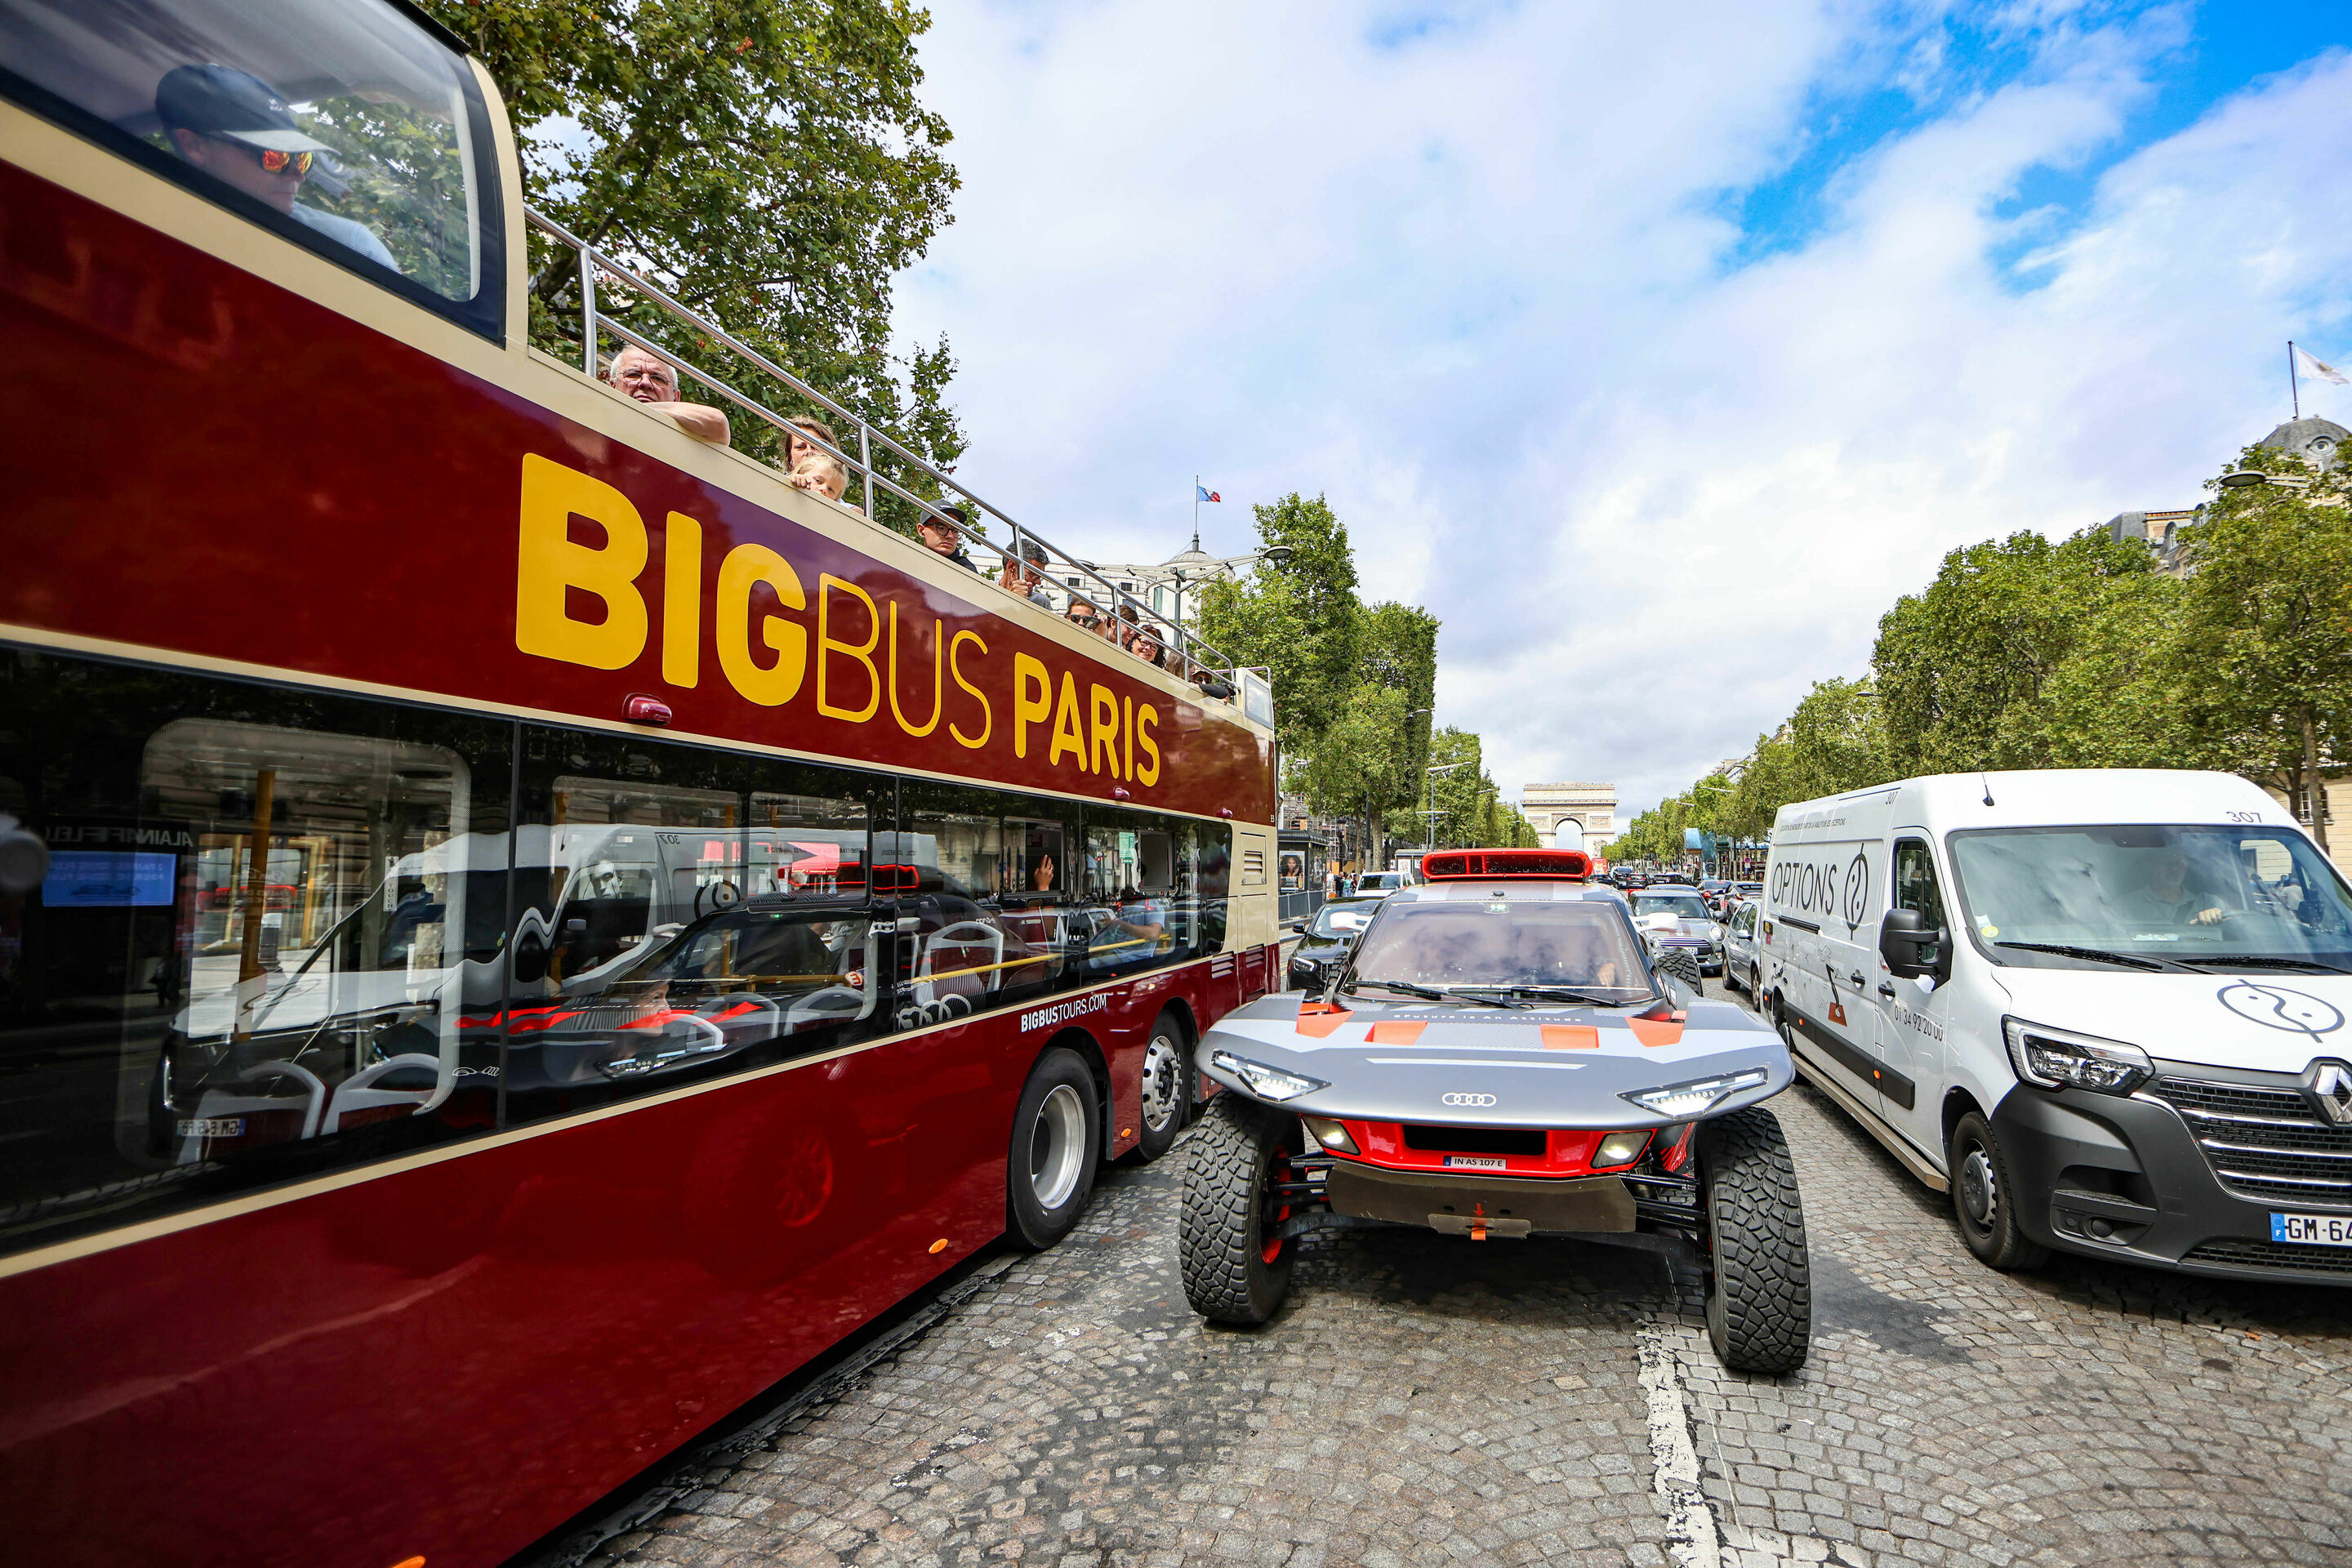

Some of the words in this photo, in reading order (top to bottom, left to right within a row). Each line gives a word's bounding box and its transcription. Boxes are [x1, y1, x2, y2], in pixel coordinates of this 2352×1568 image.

[1013, 651, 1161, 787] PARIS
[1885, 791, 1899, 805] 307
[2226, 811, 2261, 823] 307
[1772, 862, 1837, 915] OPTIONS
[1021, 993, 1107, 1032] BIGBUSTOURS.COM
[1895, 1005, 1901, 1022] 01
[1904, 1009, 1911, 1027] 34
[1913, 1013, 1921, 1031] 92
[1923, 1018, 1931, 1036] 20
[1934, 1022, 1943, 1041] 00
